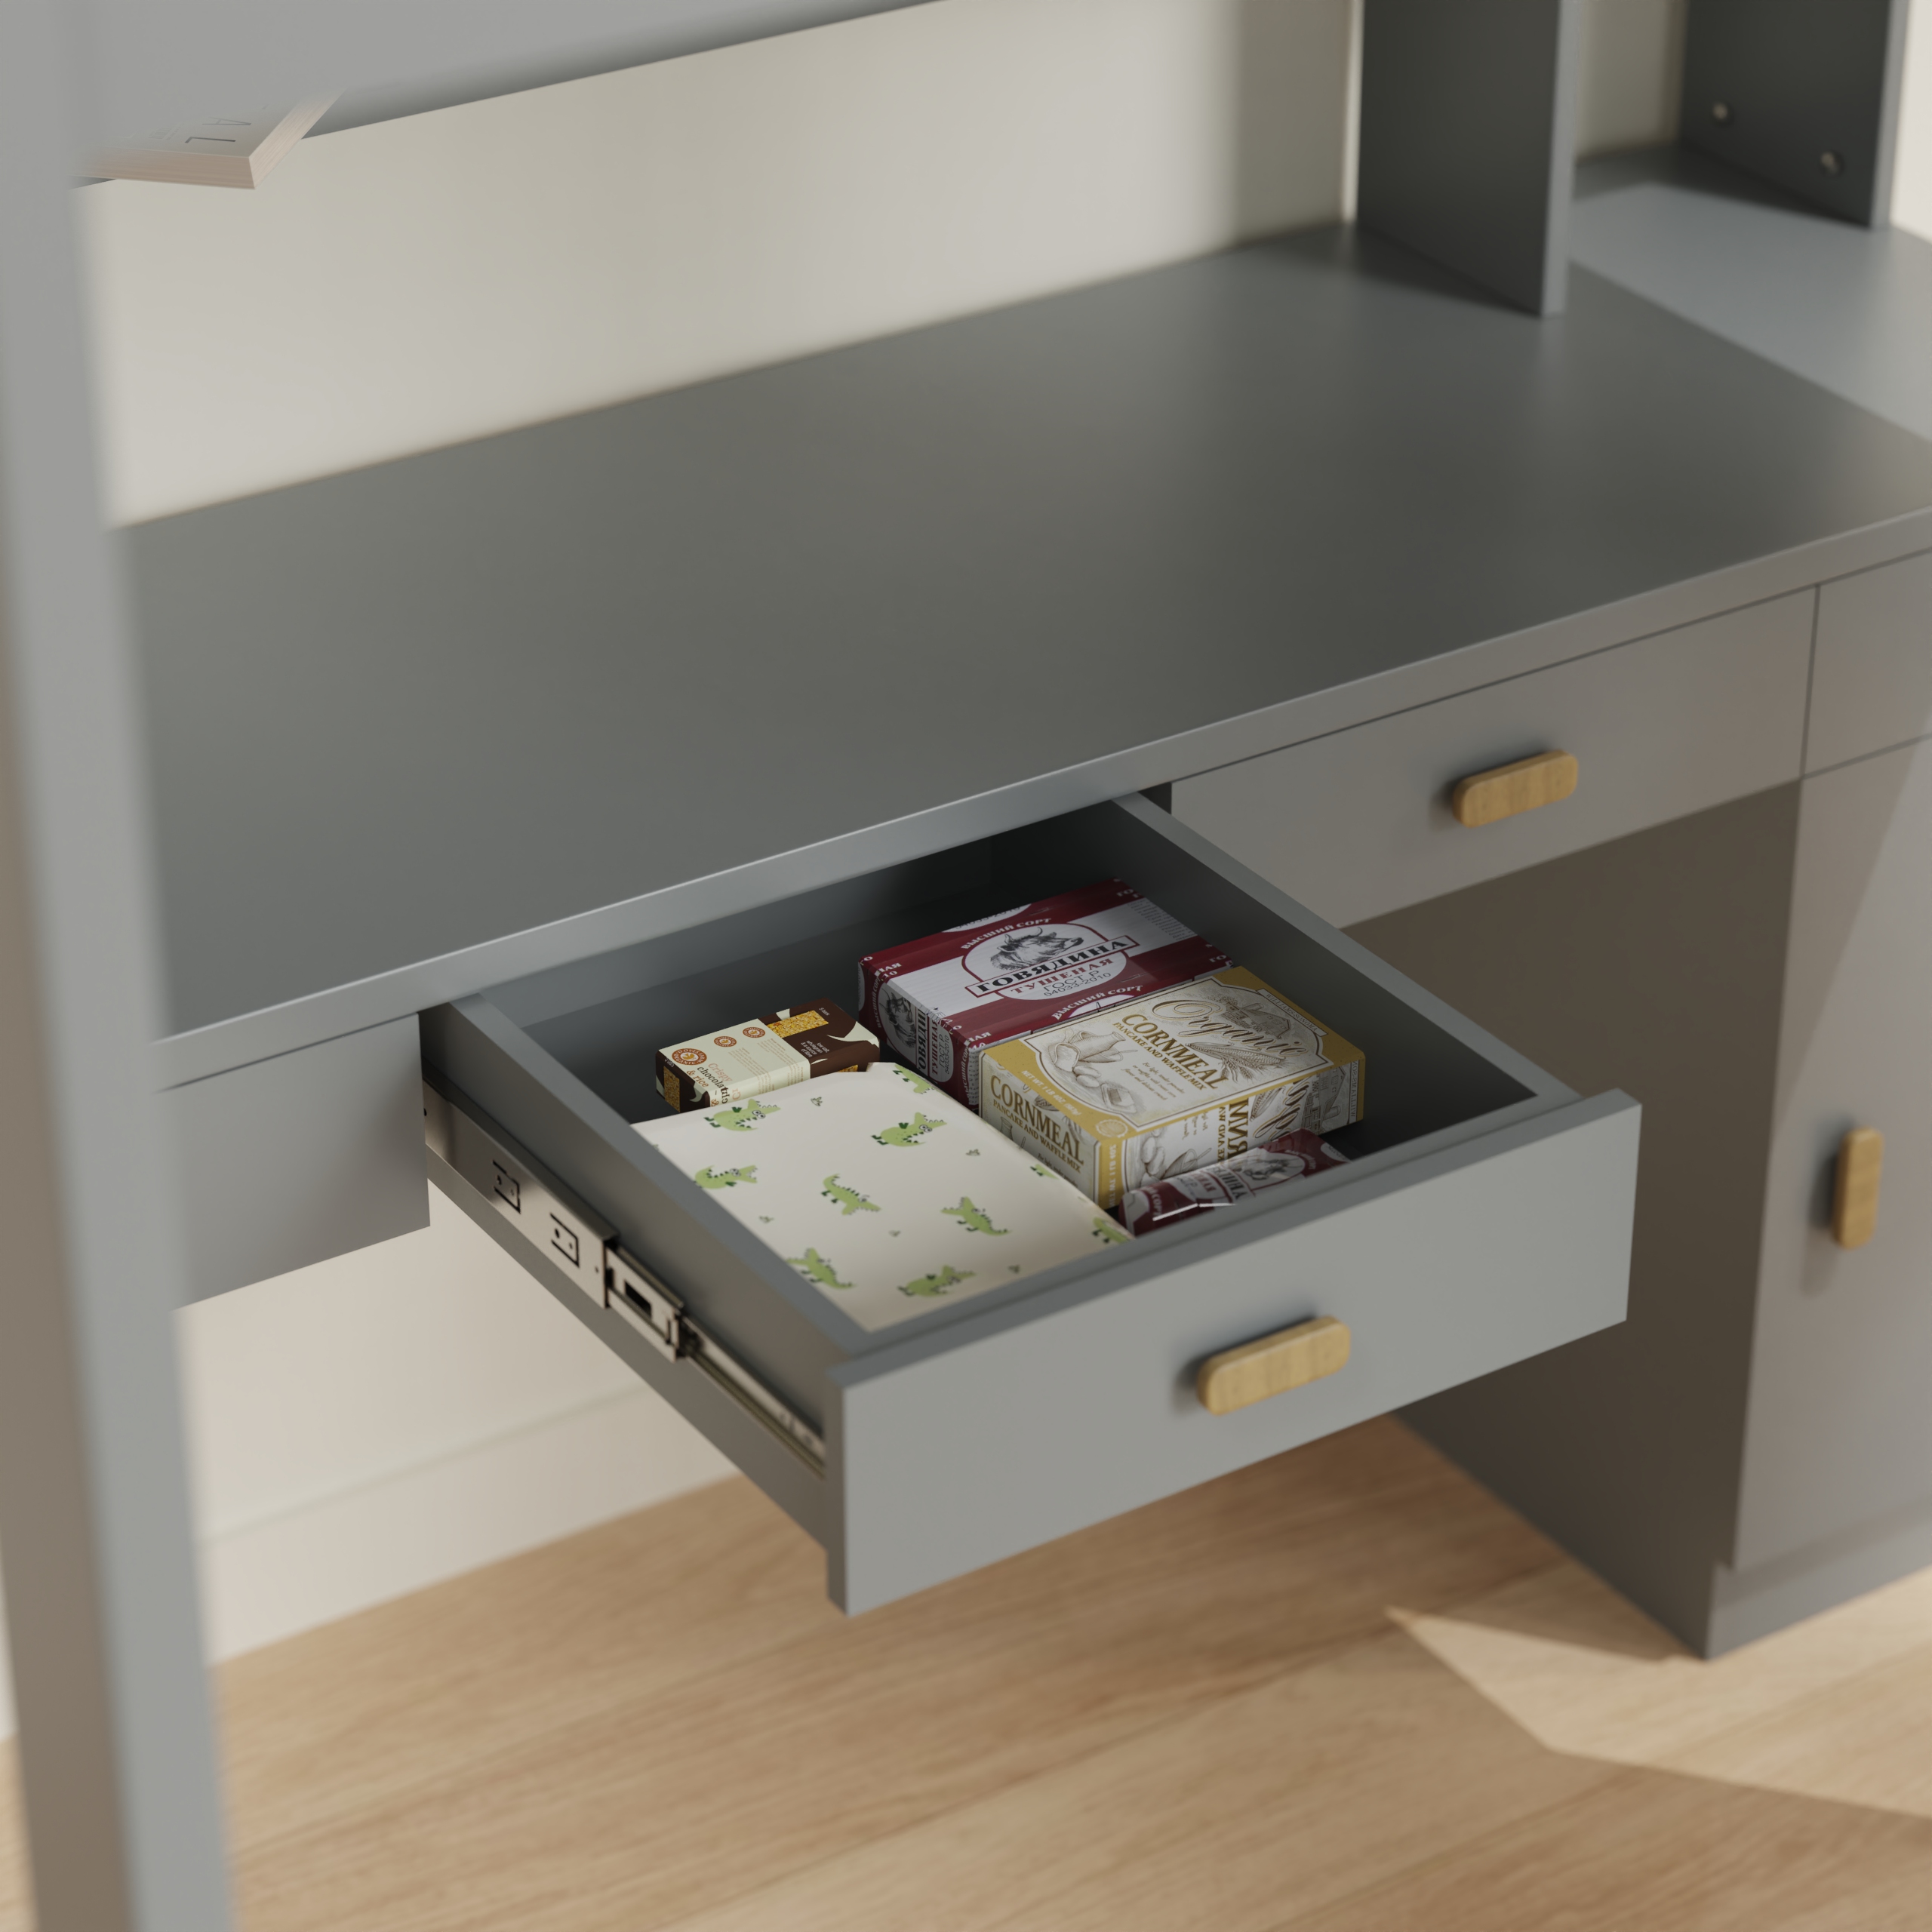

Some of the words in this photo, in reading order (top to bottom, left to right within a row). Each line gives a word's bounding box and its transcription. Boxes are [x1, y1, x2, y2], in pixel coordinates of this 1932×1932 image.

[961, 924, 1014, 949] ВЫСШИЙ
[1017, 918, 1051, 928] СОРТ
[976, 940, 1129, 993] ГОВЯДИНА
[1011, 958, 1113, 993] ТУШЕНАЯ
[1043, 975, 1084, 992] ГОСТ
[1044, 972, 1111, 996] 54033-2010
[1051, 992, 1106, 1020] ВЫСШИЙ
[1108, 986, 1143, 995] СОРТ
[1266, 993, 1318, 1031] WILLIAMS-SONOMA
[918, 1008, 927, 1070] ОВЯДИ
[1152, 999, 1309, 1057] Organic
[1112, 1022, 1148, 1049] PANCAKE
[1144, 1045, 1163, 1058] AND
[1161, 1057, 1192, 1080] WAFFLE
[1187, 1076, 1207, 1091] MIX
[1121, 1014, 1229, 1090] CORNMEAL
[693, 1075, 709, 1088] rice
[708, 1063, 733, 1081] Crispy
[1021, 1070, 1035, 1079] NET
[990, 1075, 1084, 1165] CORNMEAL
[992, 1099, 1023, 1128] PANCAKE
[1023, 1124, 1039, 1140] AND
[1039, 1135, 1066, 1163] WAFFLE
[1067, 1156, 1081, 1174] MIX
